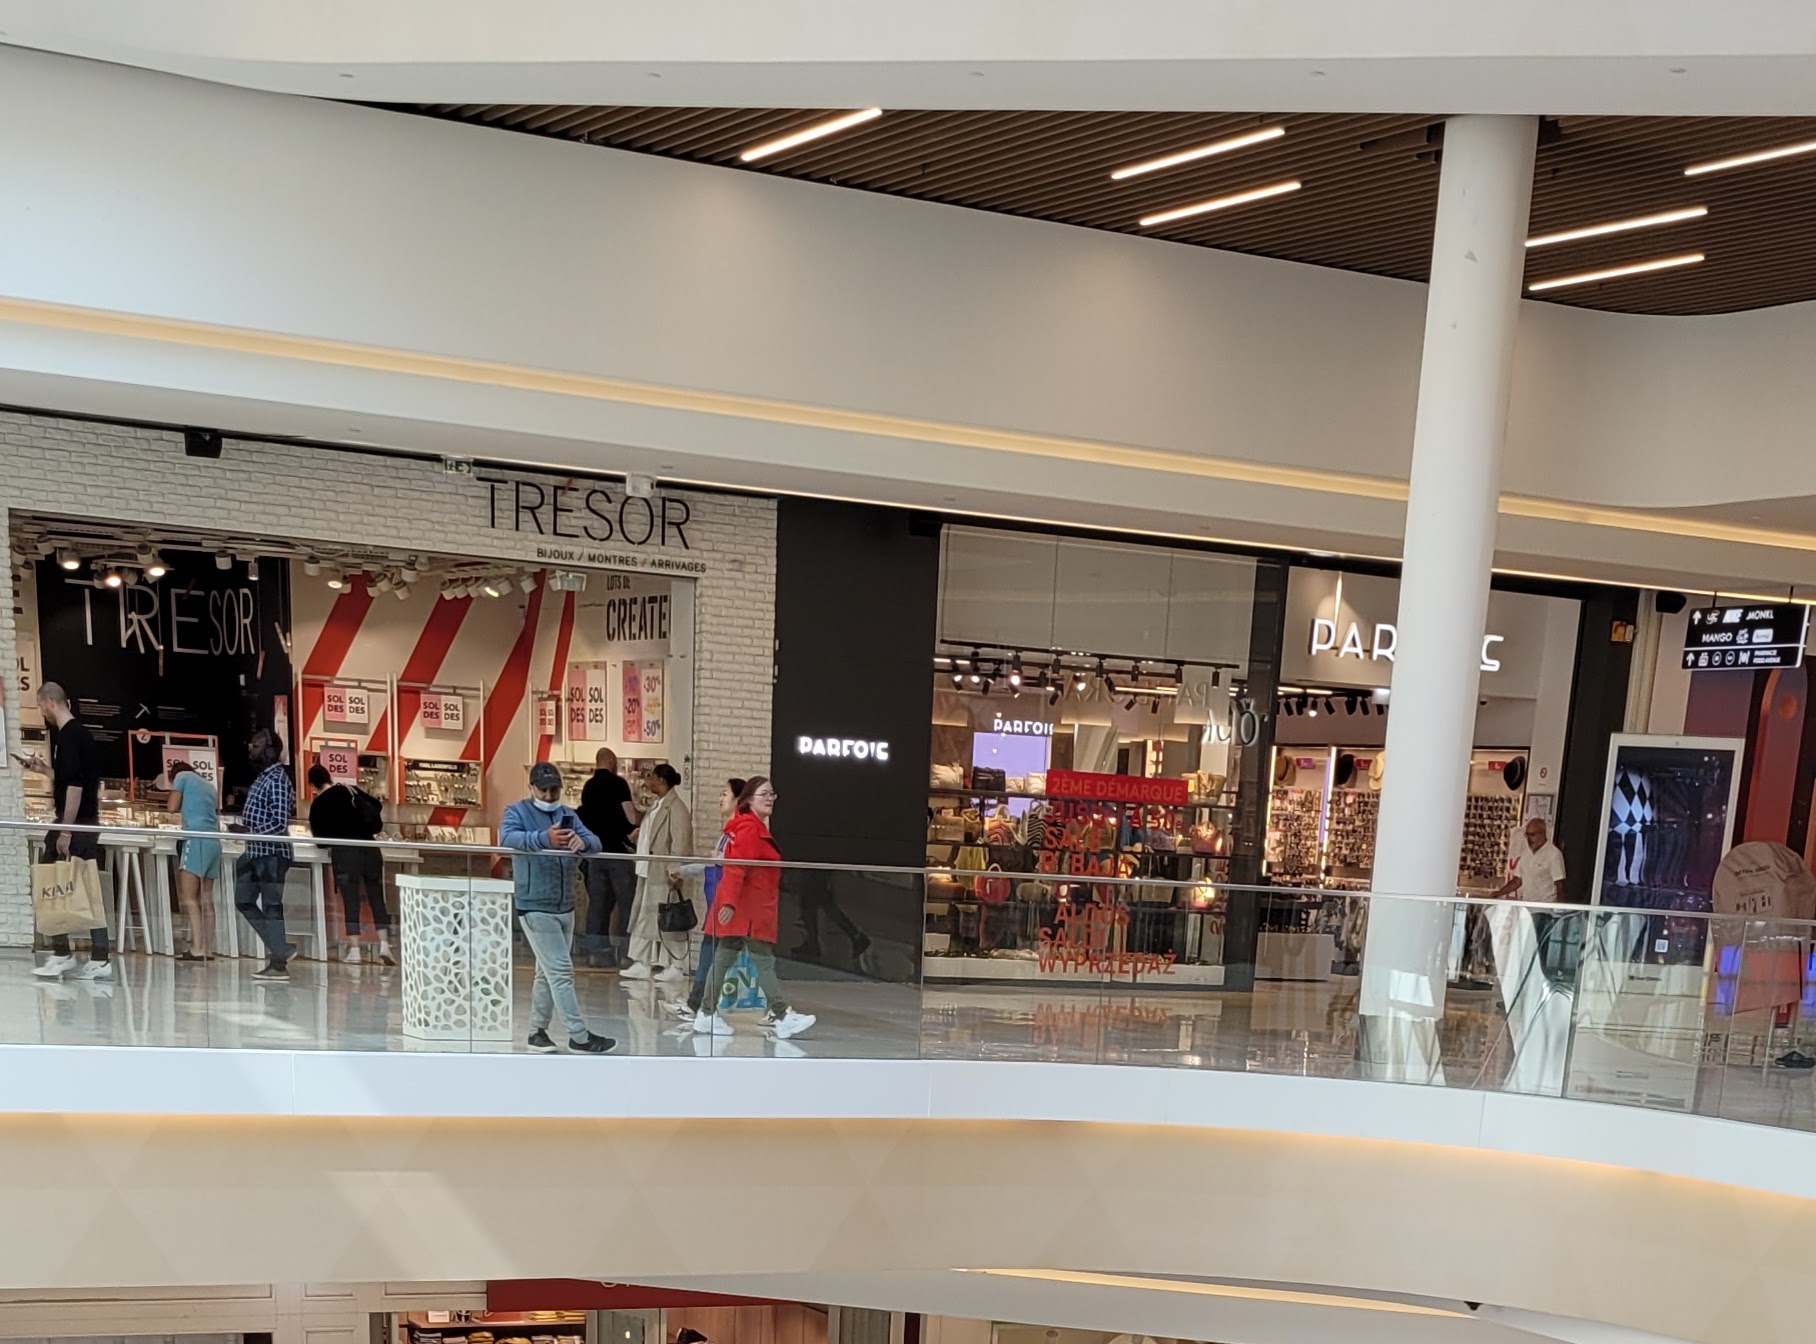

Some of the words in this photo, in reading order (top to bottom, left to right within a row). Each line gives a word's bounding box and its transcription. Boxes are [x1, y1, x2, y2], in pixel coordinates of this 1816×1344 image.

[476, 476, 691, 550] TRÉSOR
[537, 547, 574, 561] BIJOUX
[588, 553, 638, 567] MONTRES
[650, 559, 707, 573] ARRIVAGES
[606, 595, 671, 642] CREATE
[1311, 618, 1504, 672] PARS
[1702, 632, 1733, 643] MANGO
[327, 694, 344, 704] SOL
[348, 696, 365, 705] SOL
[571, 687, 585, 703] SOL
[588, 686, 604, 703] SOL
[327, 704, 344, 713] DES
[348, 706, 365, 715] DES
[423, 701, 440, 711] SOL
[443, 703, 461, 712] SOL
[423, 711, 440, 720] DES
[443, 712, 460, 721] DES
[571, 707, 585, 723] DES
[588, 707, 604, 723] DES
[797, 736, 889, 760] PARFOIS
[193, 760, 214, 771] SOL
[328, 753, 348, 763] SOL
[329, 764, 348, 774] DES
[1052, 774, 1091, 796] 2ÈME
[1096, 775, 1184, 802] DÉMARQUE
[1043, 826, 1100, 854] SALE
[1038, 949, 1178, 975] WYPRZEDAŻ
